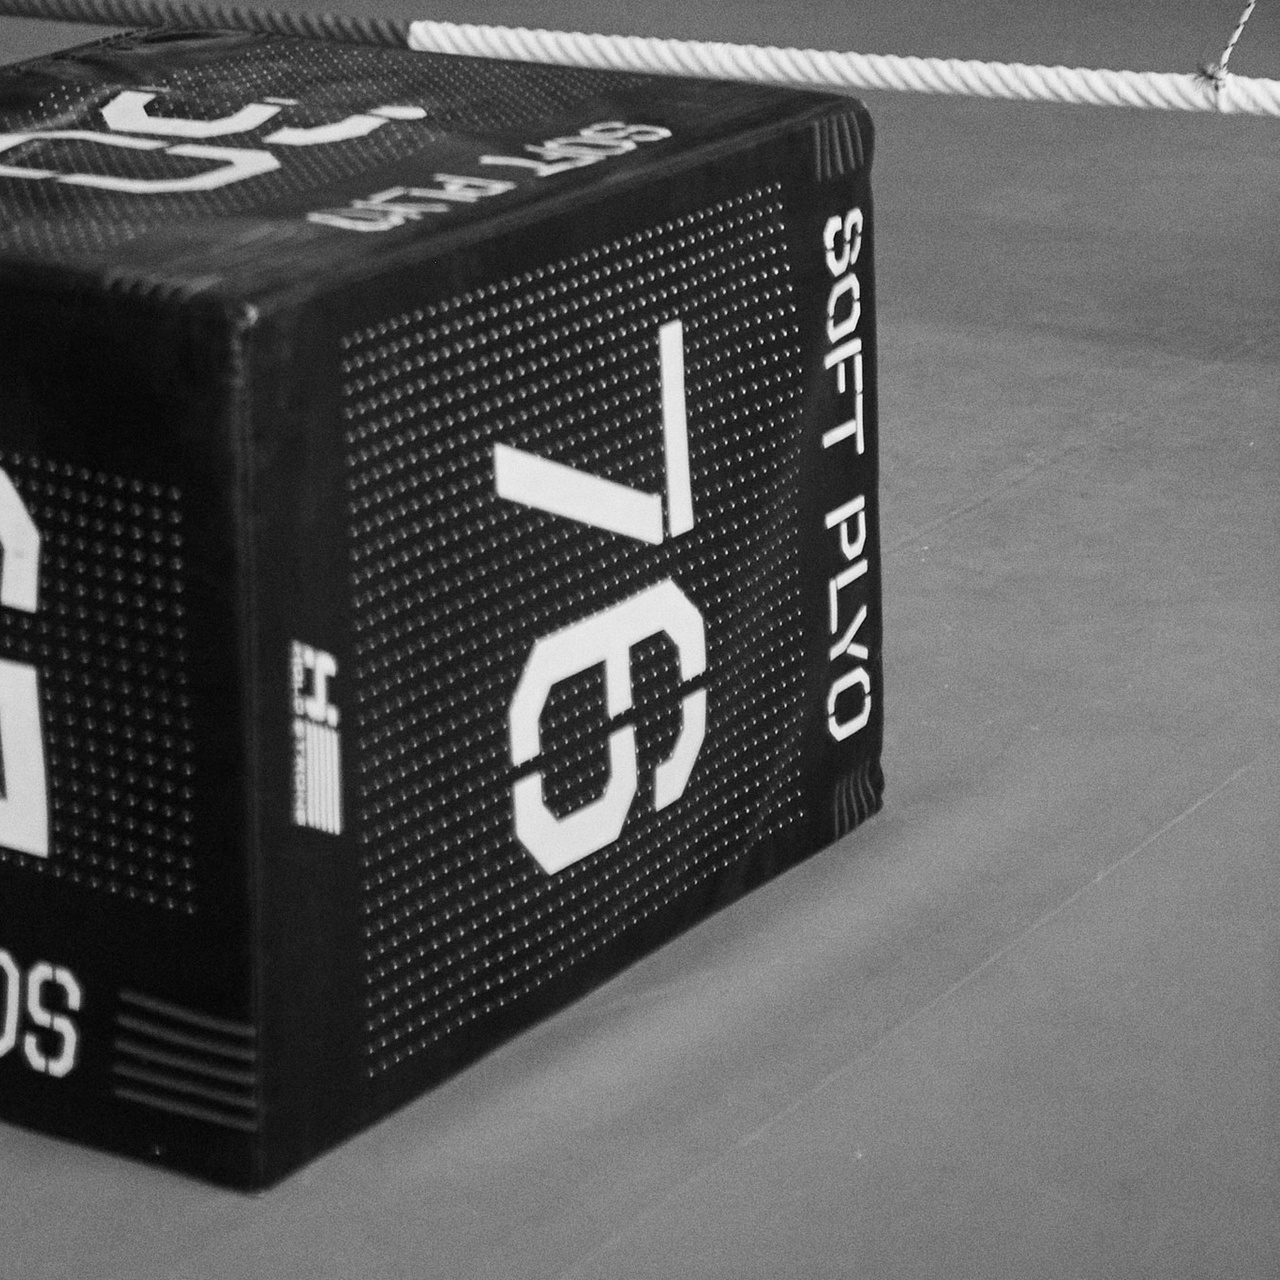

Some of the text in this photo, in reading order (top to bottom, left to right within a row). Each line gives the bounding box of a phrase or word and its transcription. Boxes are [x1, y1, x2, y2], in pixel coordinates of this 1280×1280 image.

[477, 121, 673, 178] SOFT
[493, 318, 708, 877] 76
[821, 207, 873, 743] SOFT PLYO
